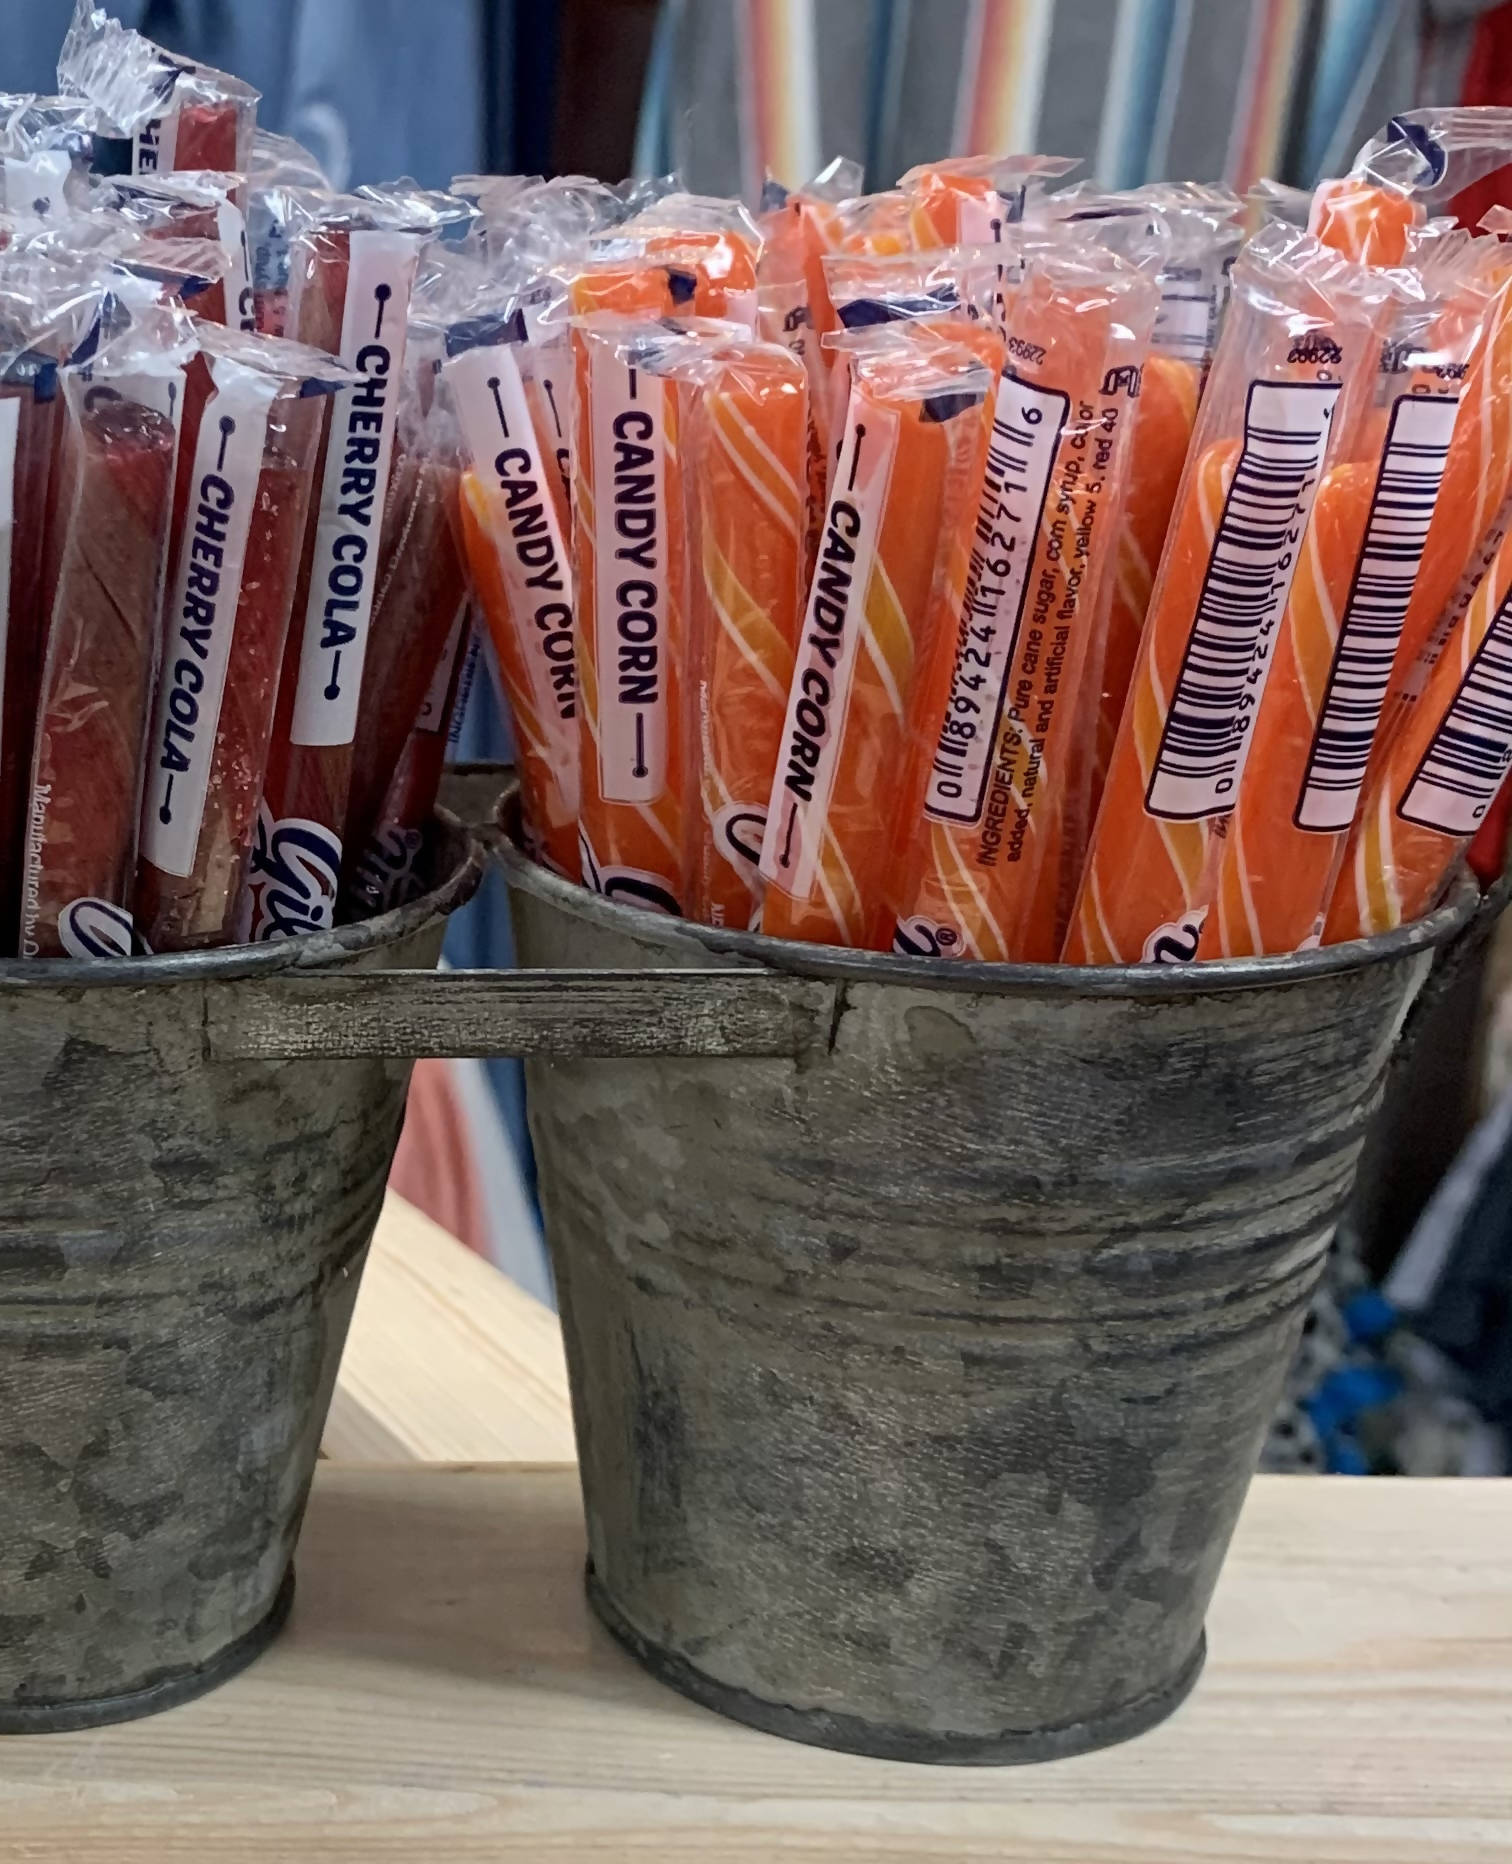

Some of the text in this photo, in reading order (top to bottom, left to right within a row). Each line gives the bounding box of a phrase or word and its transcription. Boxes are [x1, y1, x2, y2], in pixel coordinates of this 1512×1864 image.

[1092, 438, 1114, 470] red
[1102, 407, 1119, 434] 40
[320, 344, 391, 649] CHERRY COLA
[495, 448, 563, 591] CANDY
[613, 410, 659, 705] CANDY CORN
[1074, 500, 1097, 558] yellow
[160, 473, 235, 772] CHERRY COLA
[784, 499, 861, 802] CANDY CORN
[937, 406, 1043, 798] 0 89424 16271 6
[976, 727, 1023, 867] INGREDIENTS:
[1008, 679, 1033, 722] Pure
[1022, 629, 1043, 675] cane
[1033, 568, 1061, 625] sugar,
[1056, 456, 1085, 515] syrup,
[1044, 625, 1070, 695] artificial
[1022, 738, 1045, 798] natural
[1036, 700, 1054, 733] and
[24, 783, 52, 909] Manufactured
